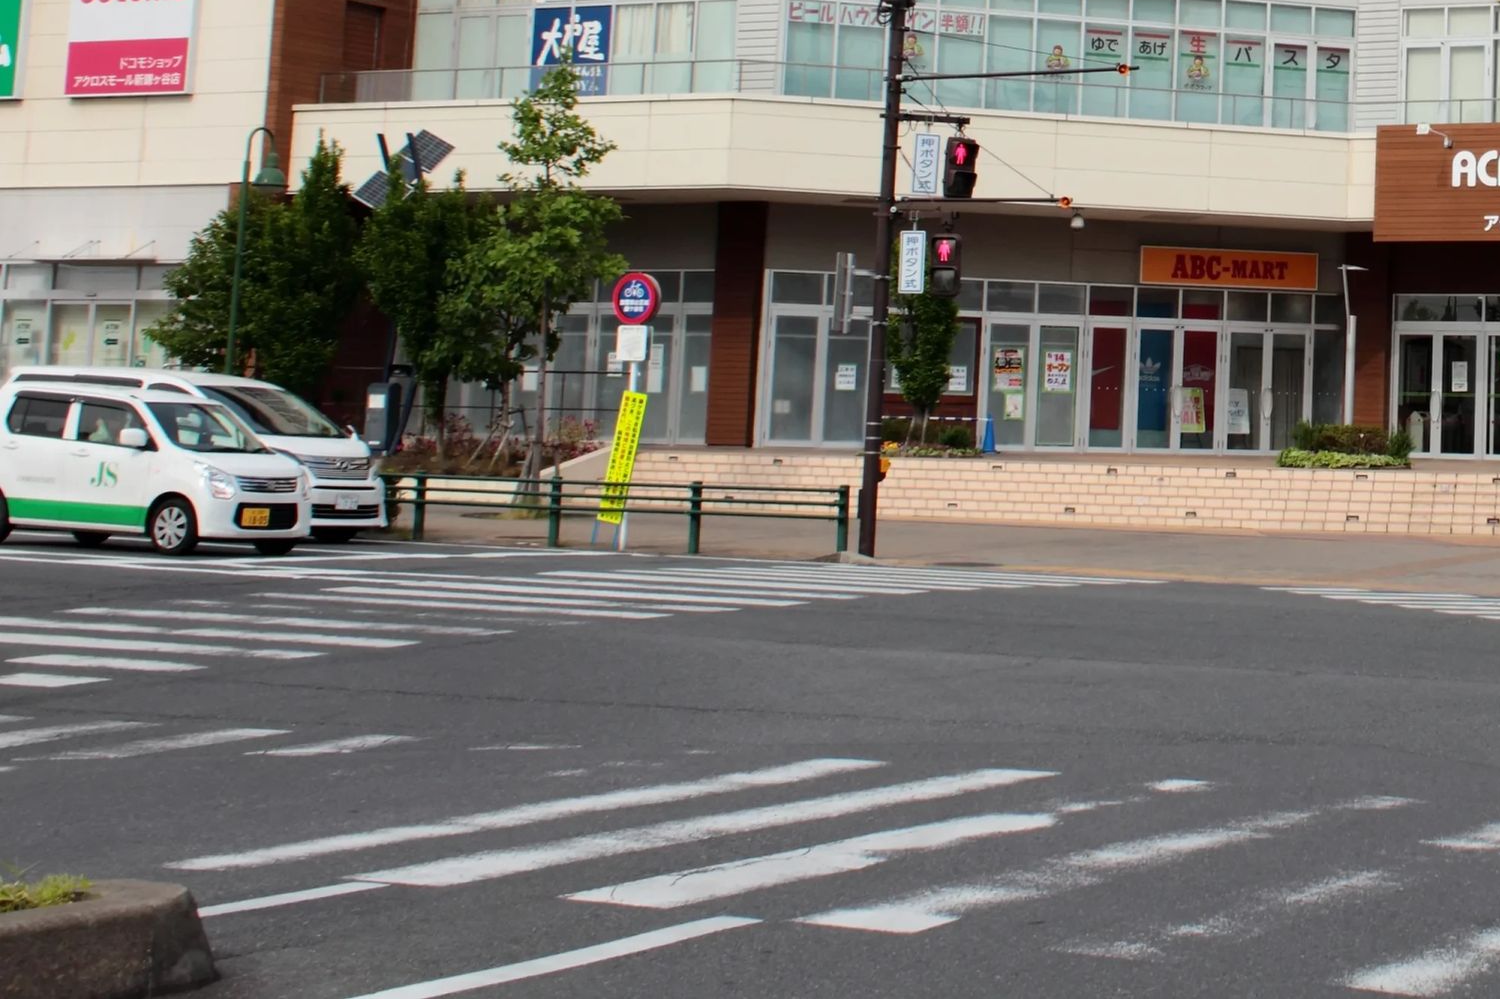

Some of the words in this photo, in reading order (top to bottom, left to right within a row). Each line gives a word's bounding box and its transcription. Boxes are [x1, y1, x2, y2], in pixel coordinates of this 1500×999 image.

[536, 14, 605, 66] 大戸屋
[119, 56, 183, 70] ドコモショップ
[917, 137, 935, 192] 押ボタン式
[904, 235, 919, 289] 押ボタン式
[1171, 254, 1288, 281] ABC-MART
[90, 461, 119, 488] JS
